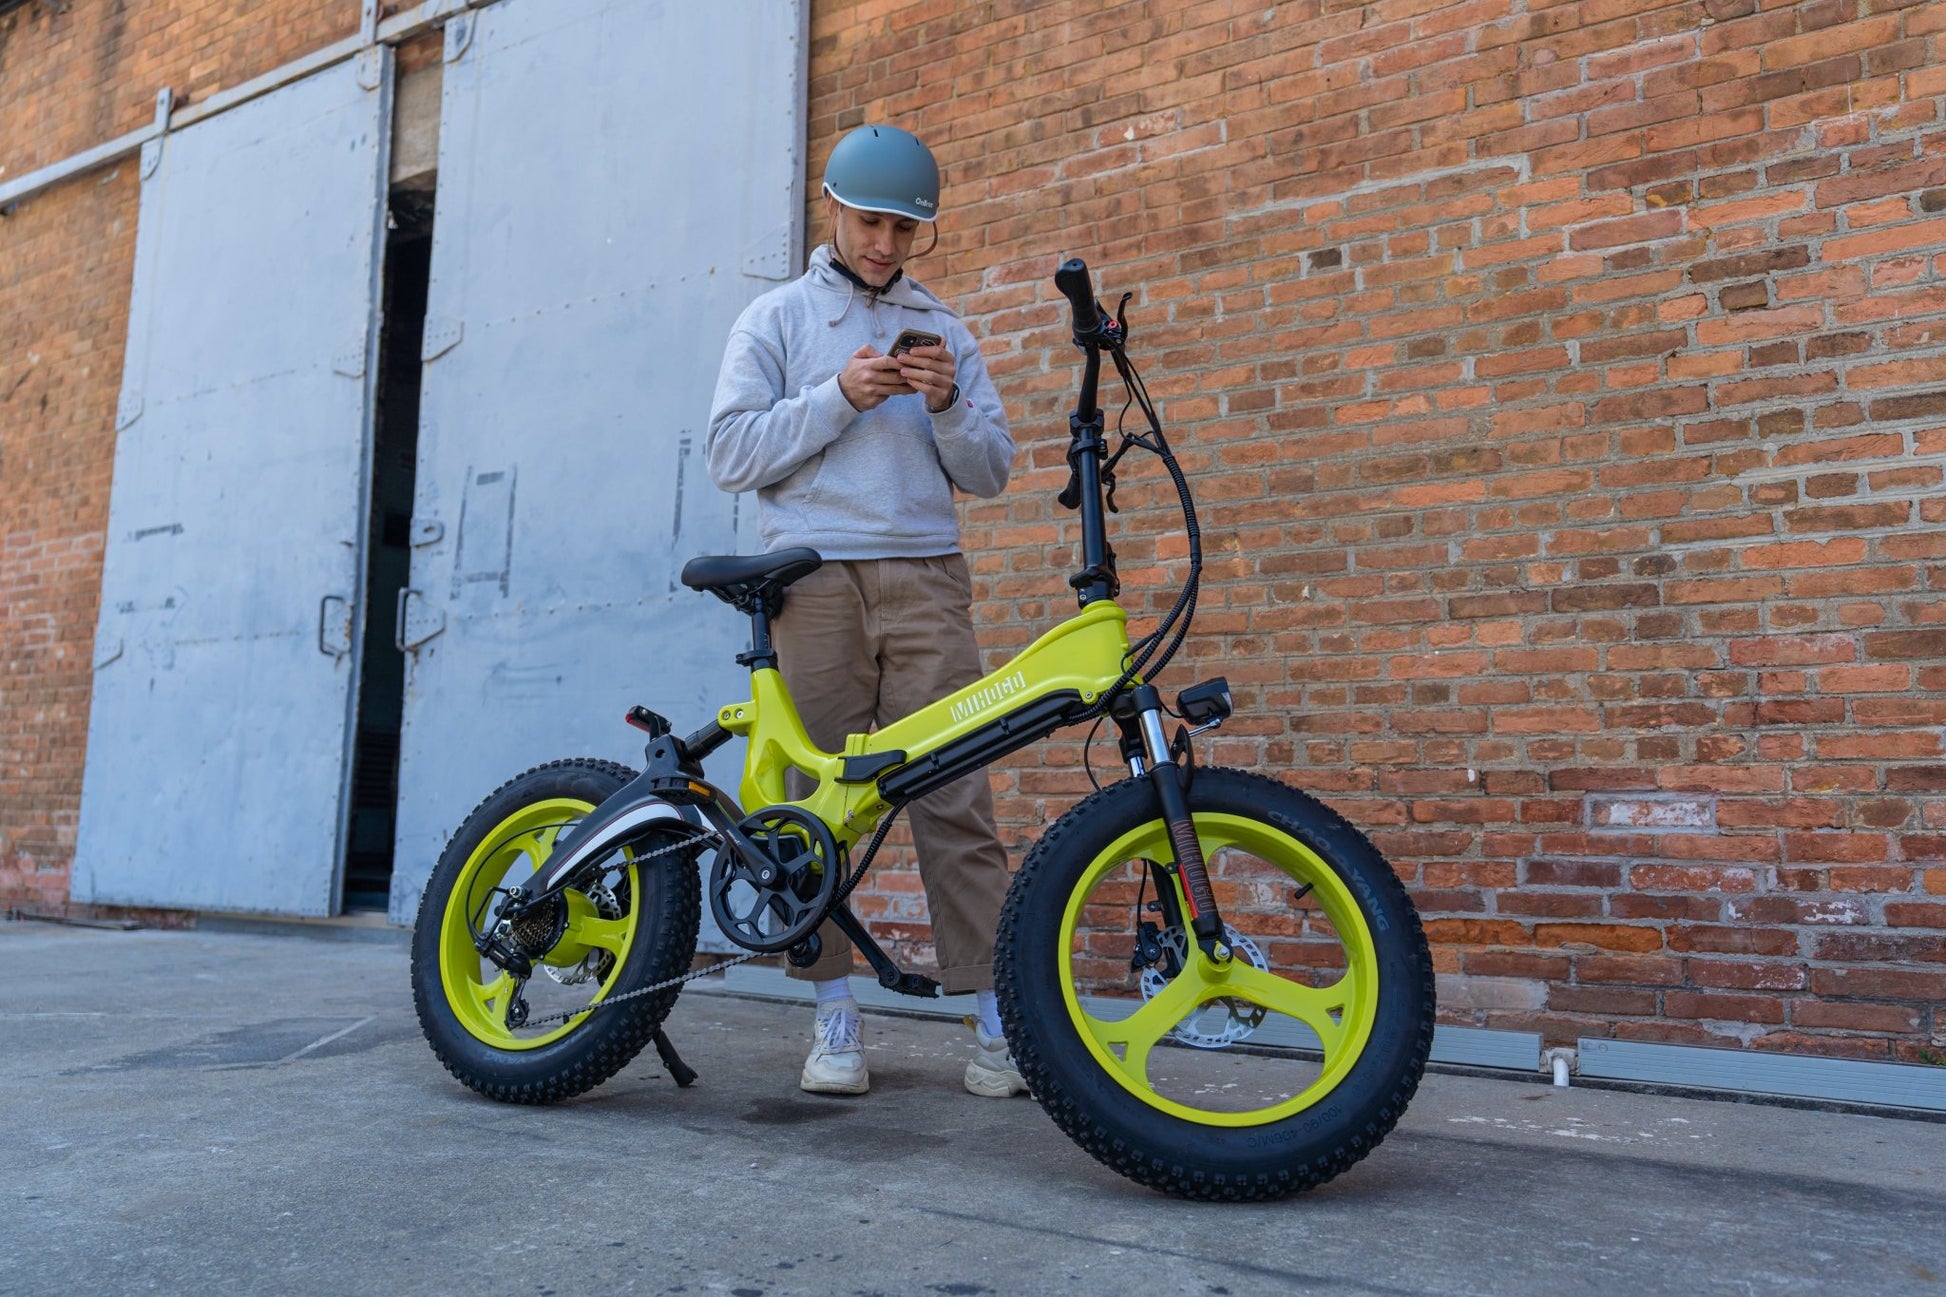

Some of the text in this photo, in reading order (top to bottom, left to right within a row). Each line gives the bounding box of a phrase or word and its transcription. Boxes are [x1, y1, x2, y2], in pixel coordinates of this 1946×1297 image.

[1170, 819, 1218, 914] MIHOGO
[1267, 810, 1390, 931] CHAO YANG
